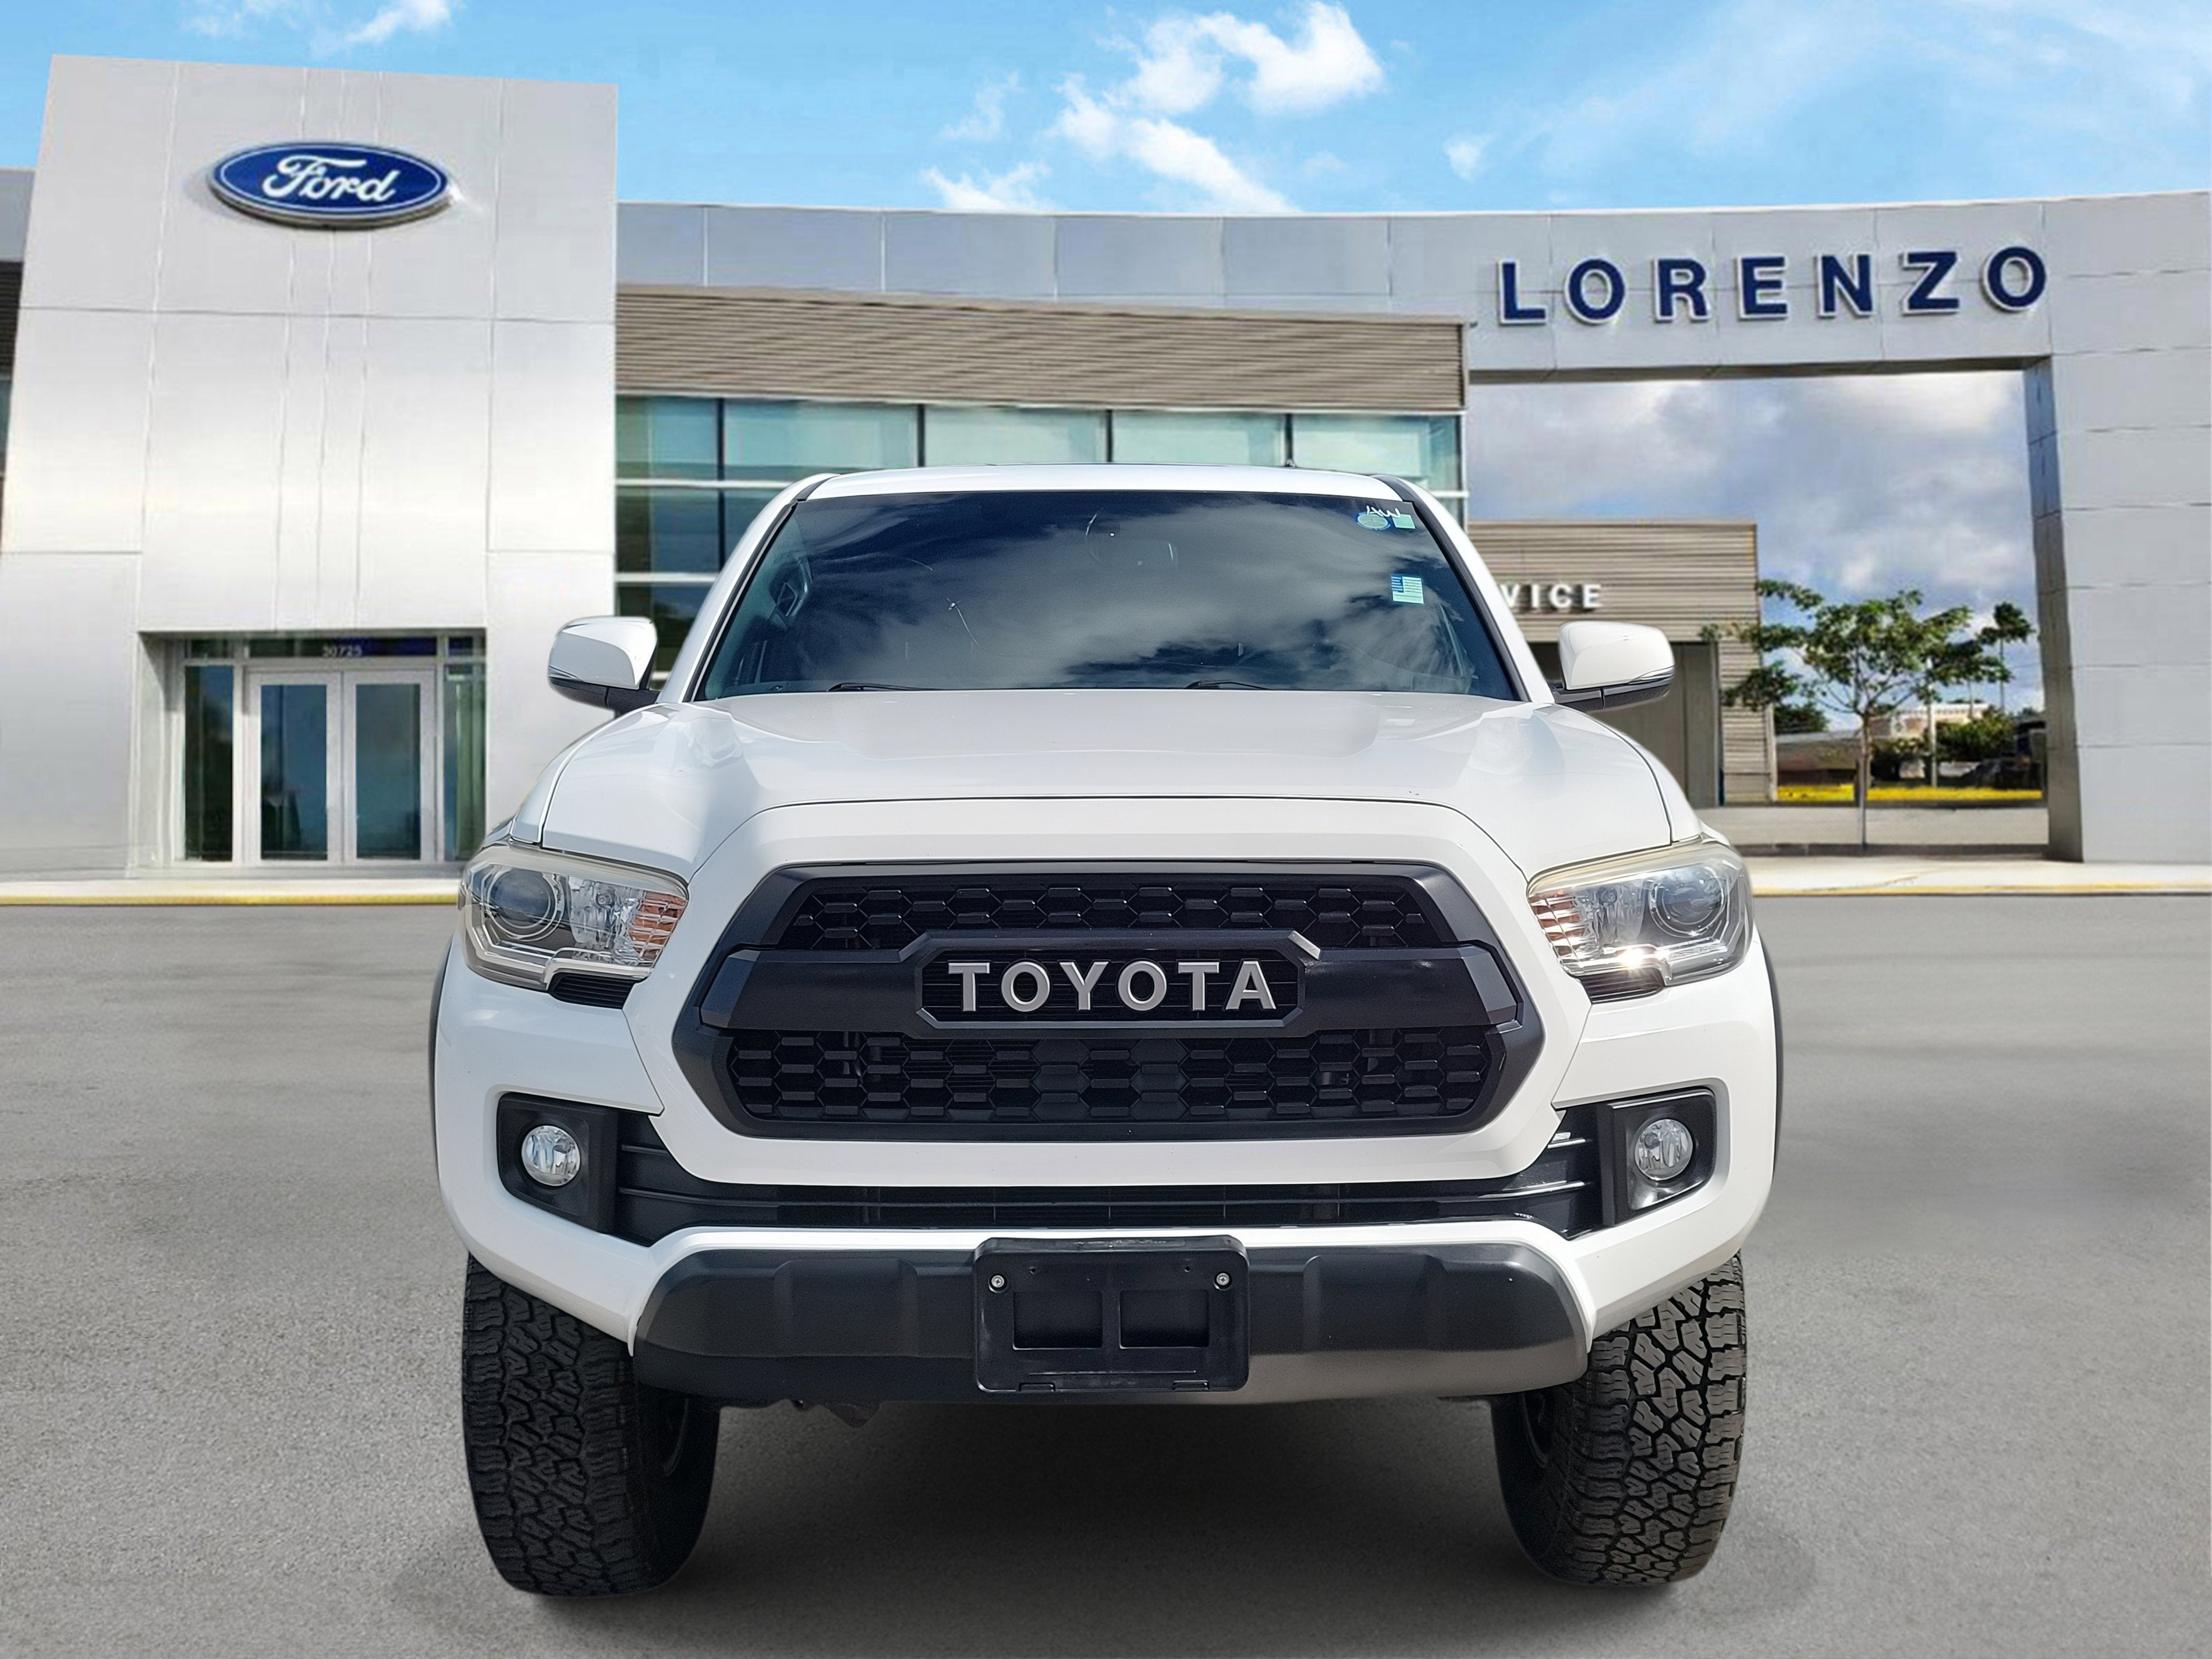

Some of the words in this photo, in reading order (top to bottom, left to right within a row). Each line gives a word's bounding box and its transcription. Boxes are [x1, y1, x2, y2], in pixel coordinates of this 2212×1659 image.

[263, 154, 400, 202] Ford
[1498, 246, 2047, 324] LORENZO
[948, 959, 1277, 1012] TOYOTA
